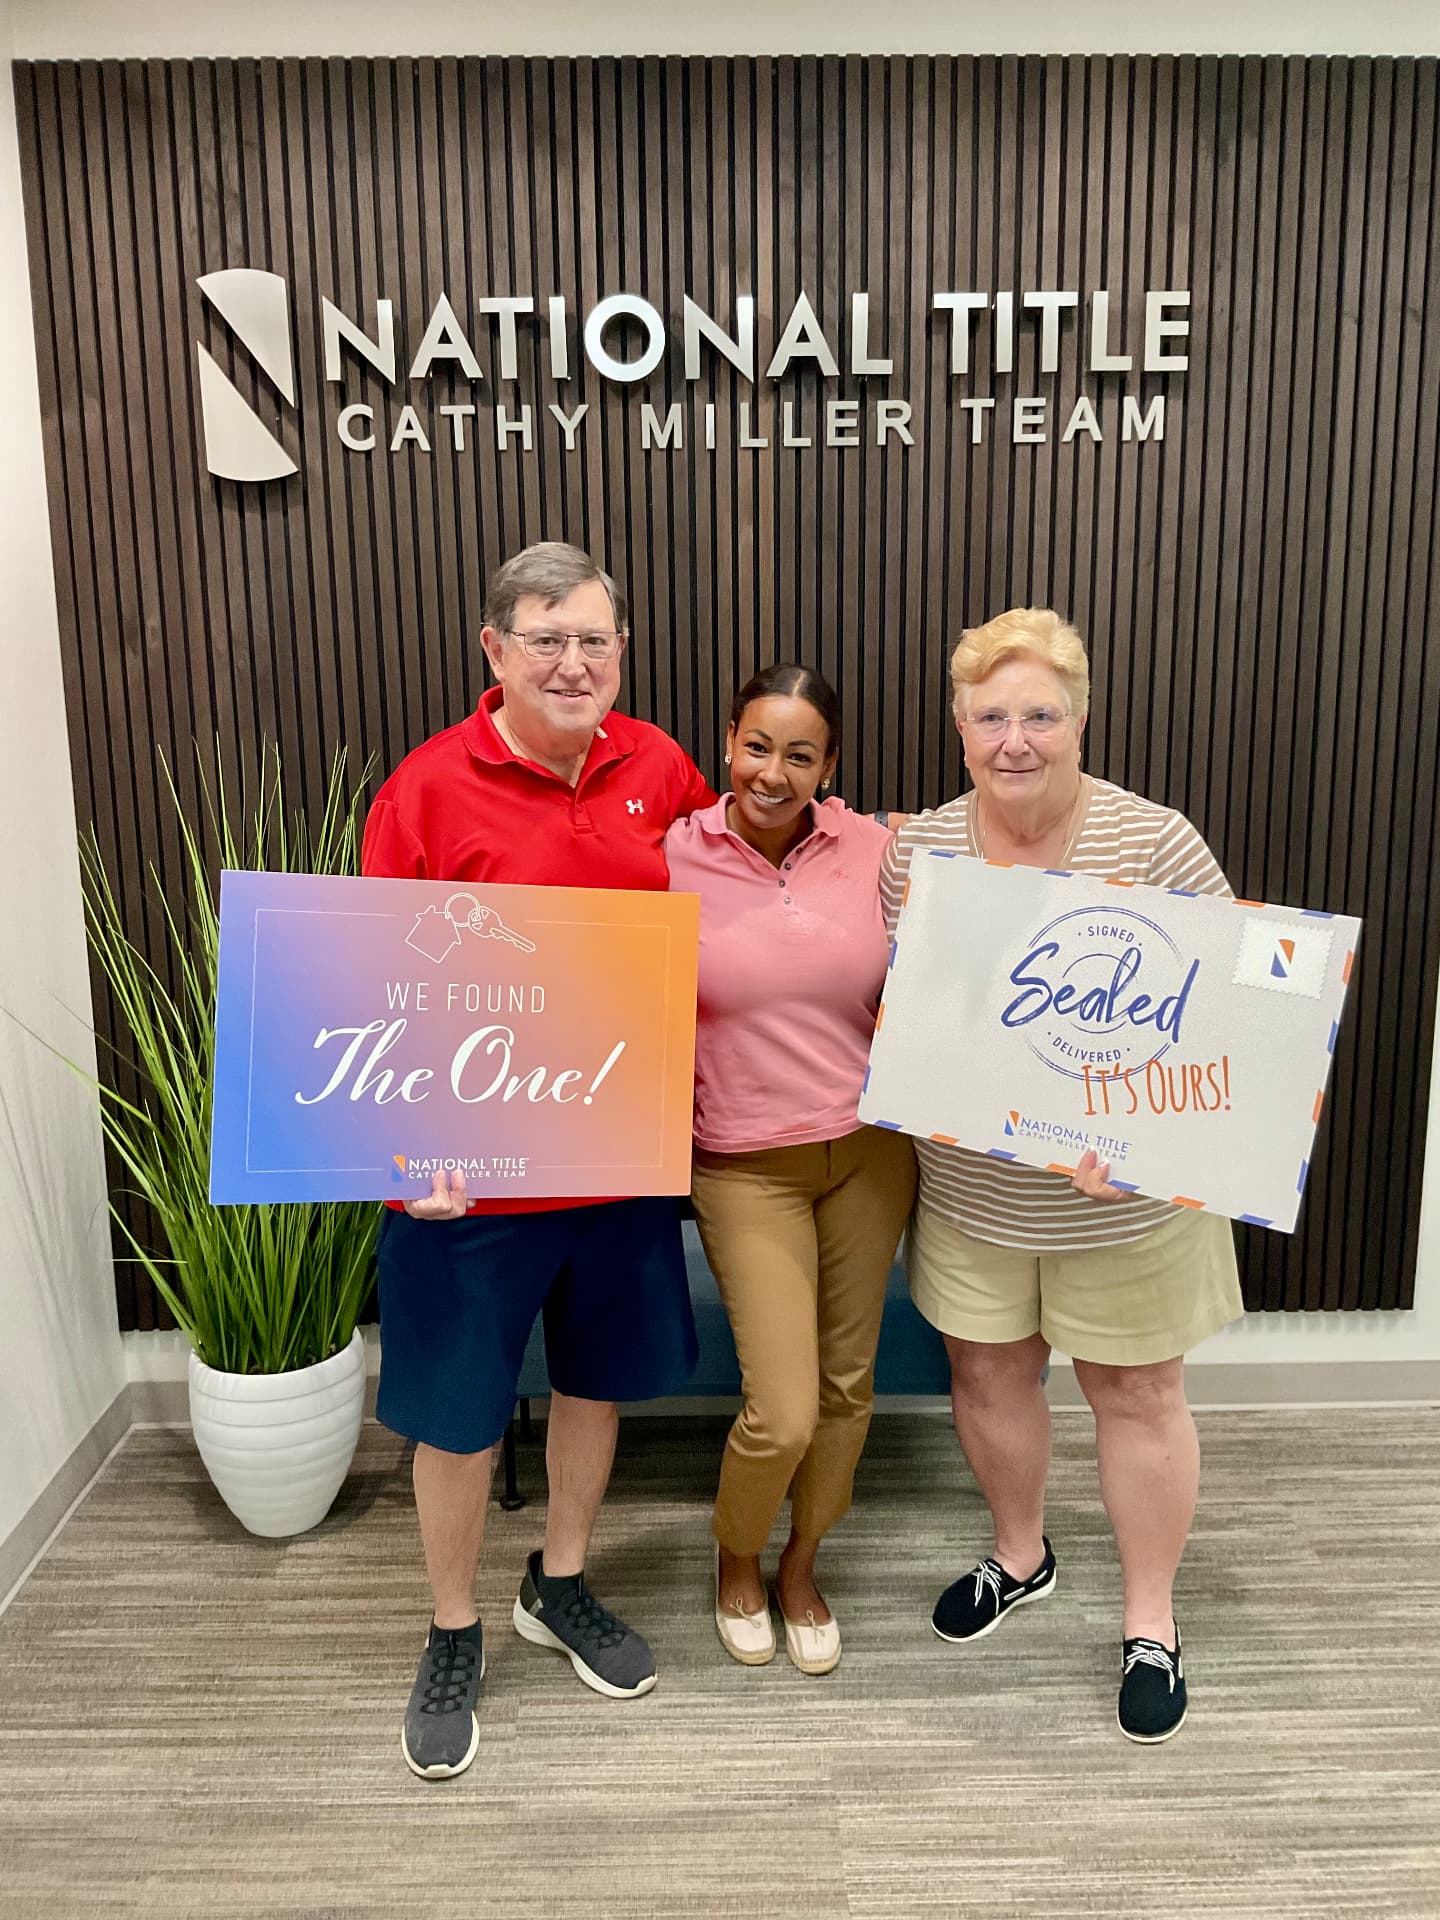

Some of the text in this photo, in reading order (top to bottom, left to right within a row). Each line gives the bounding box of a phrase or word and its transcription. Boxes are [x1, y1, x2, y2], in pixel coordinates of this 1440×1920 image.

[321, 290, 1191, 385] NATIONAL TITLE
[337, 395, 1166, 452] CATHY MILLER TEAM
[1087, 925, 1136, 944] SIGNED
[386, 982, 545, 1013] WE FOUND
[1001, 942, 1200, 1043] Sealed
[295, 1018, 626, 1105] The One!
[1052, 1036, 1122, 1062] DELIVERED
[1081, 1055, 1231, 1115] IT'S OURS!
[1019, 1129, 1126, 1161] CATHY MILLE TEAM
[1020, 1117, 1129, 1153] NATIONAL TITLE
[408, 1157, 526, 1170] NATIONAL TITLE
